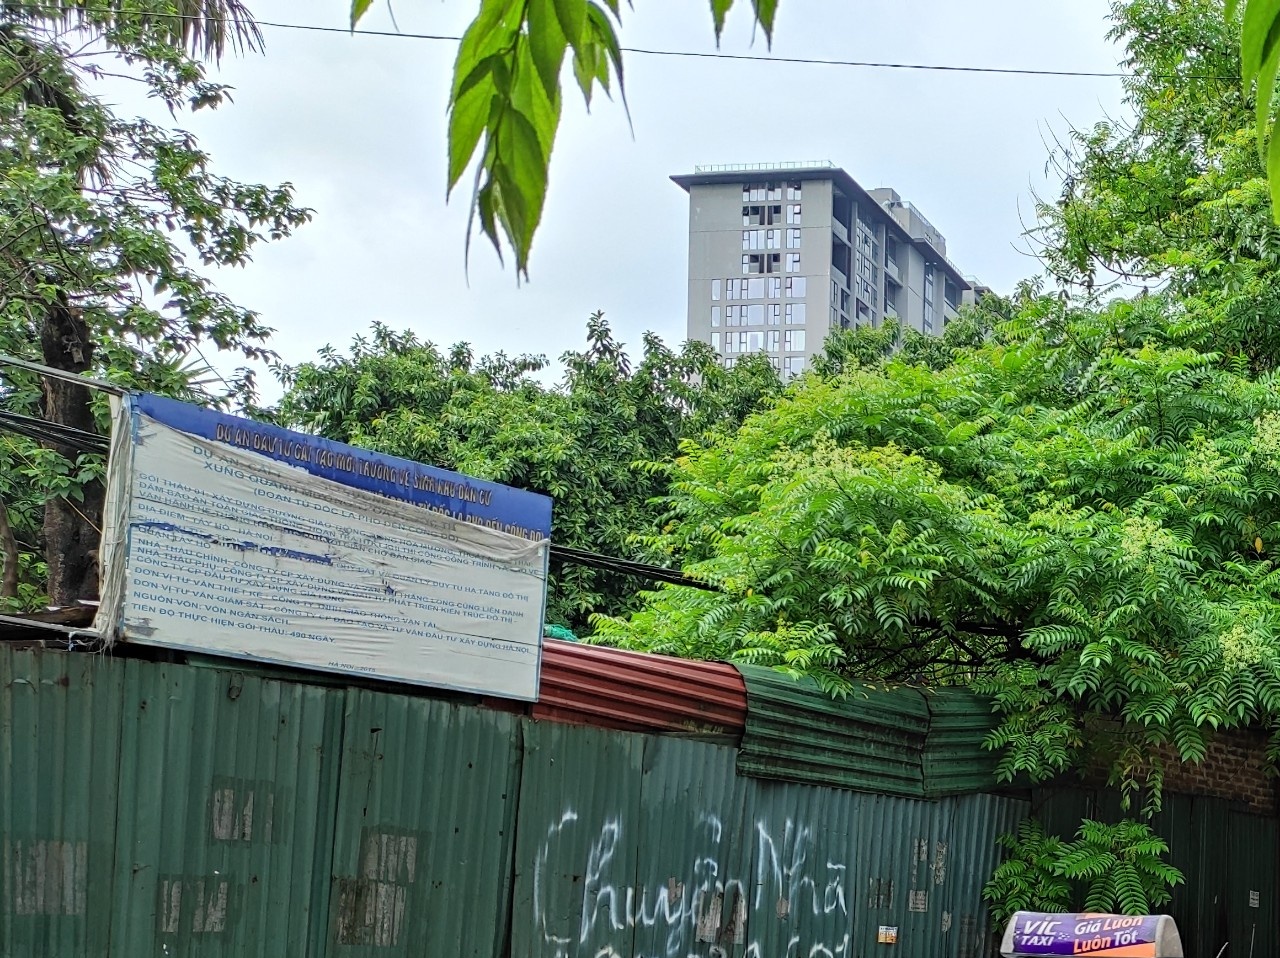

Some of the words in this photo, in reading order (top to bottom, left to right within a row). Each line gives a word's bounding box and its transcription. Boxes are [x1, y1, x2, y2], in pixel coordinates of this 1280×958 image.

[1074, 919, 1101, 935] Giá
[1021, 935, 1054, 946] TAXI
[1074, 935, 1112, 954] Luôn
[1114, 928, 1138, 946] Tốt
